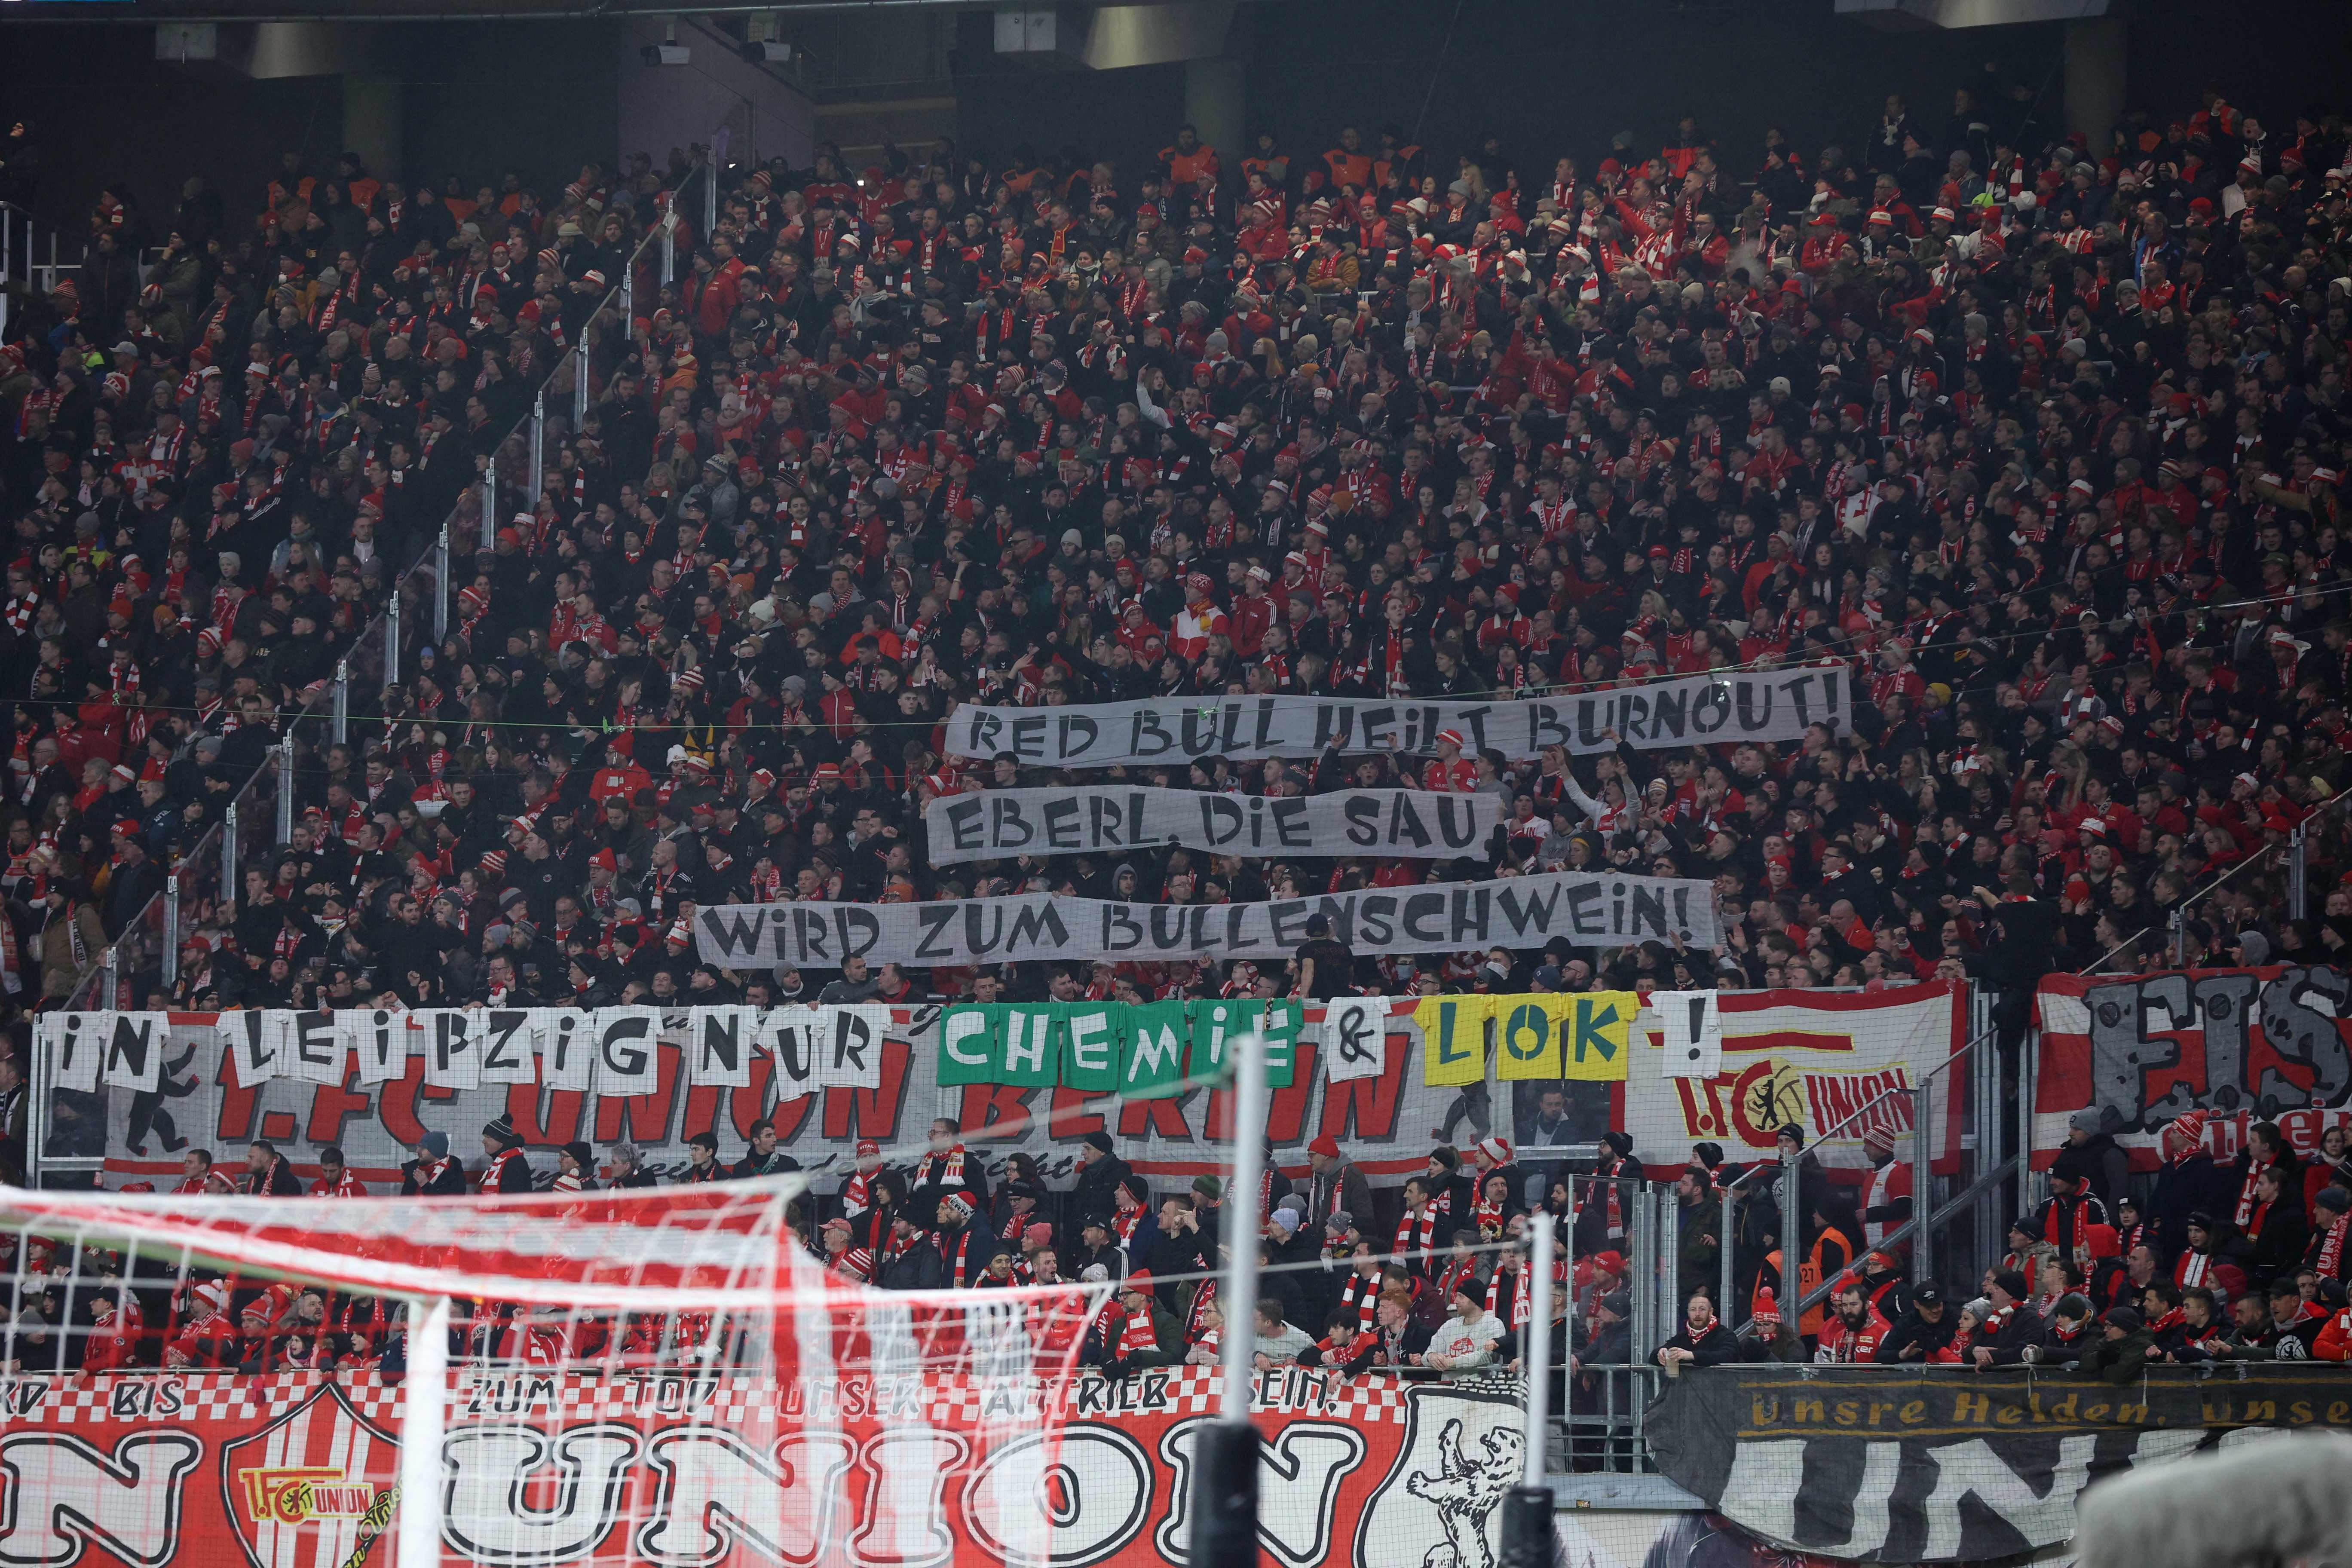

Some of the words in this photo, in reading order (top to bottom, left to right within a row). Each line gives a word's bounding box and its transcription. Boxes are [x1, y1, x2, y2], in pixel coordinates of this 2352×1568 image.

[970, 710, 1098, 759] RED
[1130, 698, 1285, 756] BULL
[1528, 673, 1838, 752] BURNOUT!
[916, 900, 1069, 958] ZUM
[703, 1011, 870, 1081] NUR
[1340, 1006, 1377, 1064] &
[1439, 998, 1620, 1065] LOK
[113, 1380, 181, 1415] BIS
[469, 1379, 558, 1413] ZUM
[633, 1377, 716, 1412] TOD
[780, 1375, 921, 1415] UNSER
[984, 1374, 1170, 1415] ANTRIEB
[314, 1487, 369, 1514] UNION
[441, 1421, 1367, 1568] UNION
